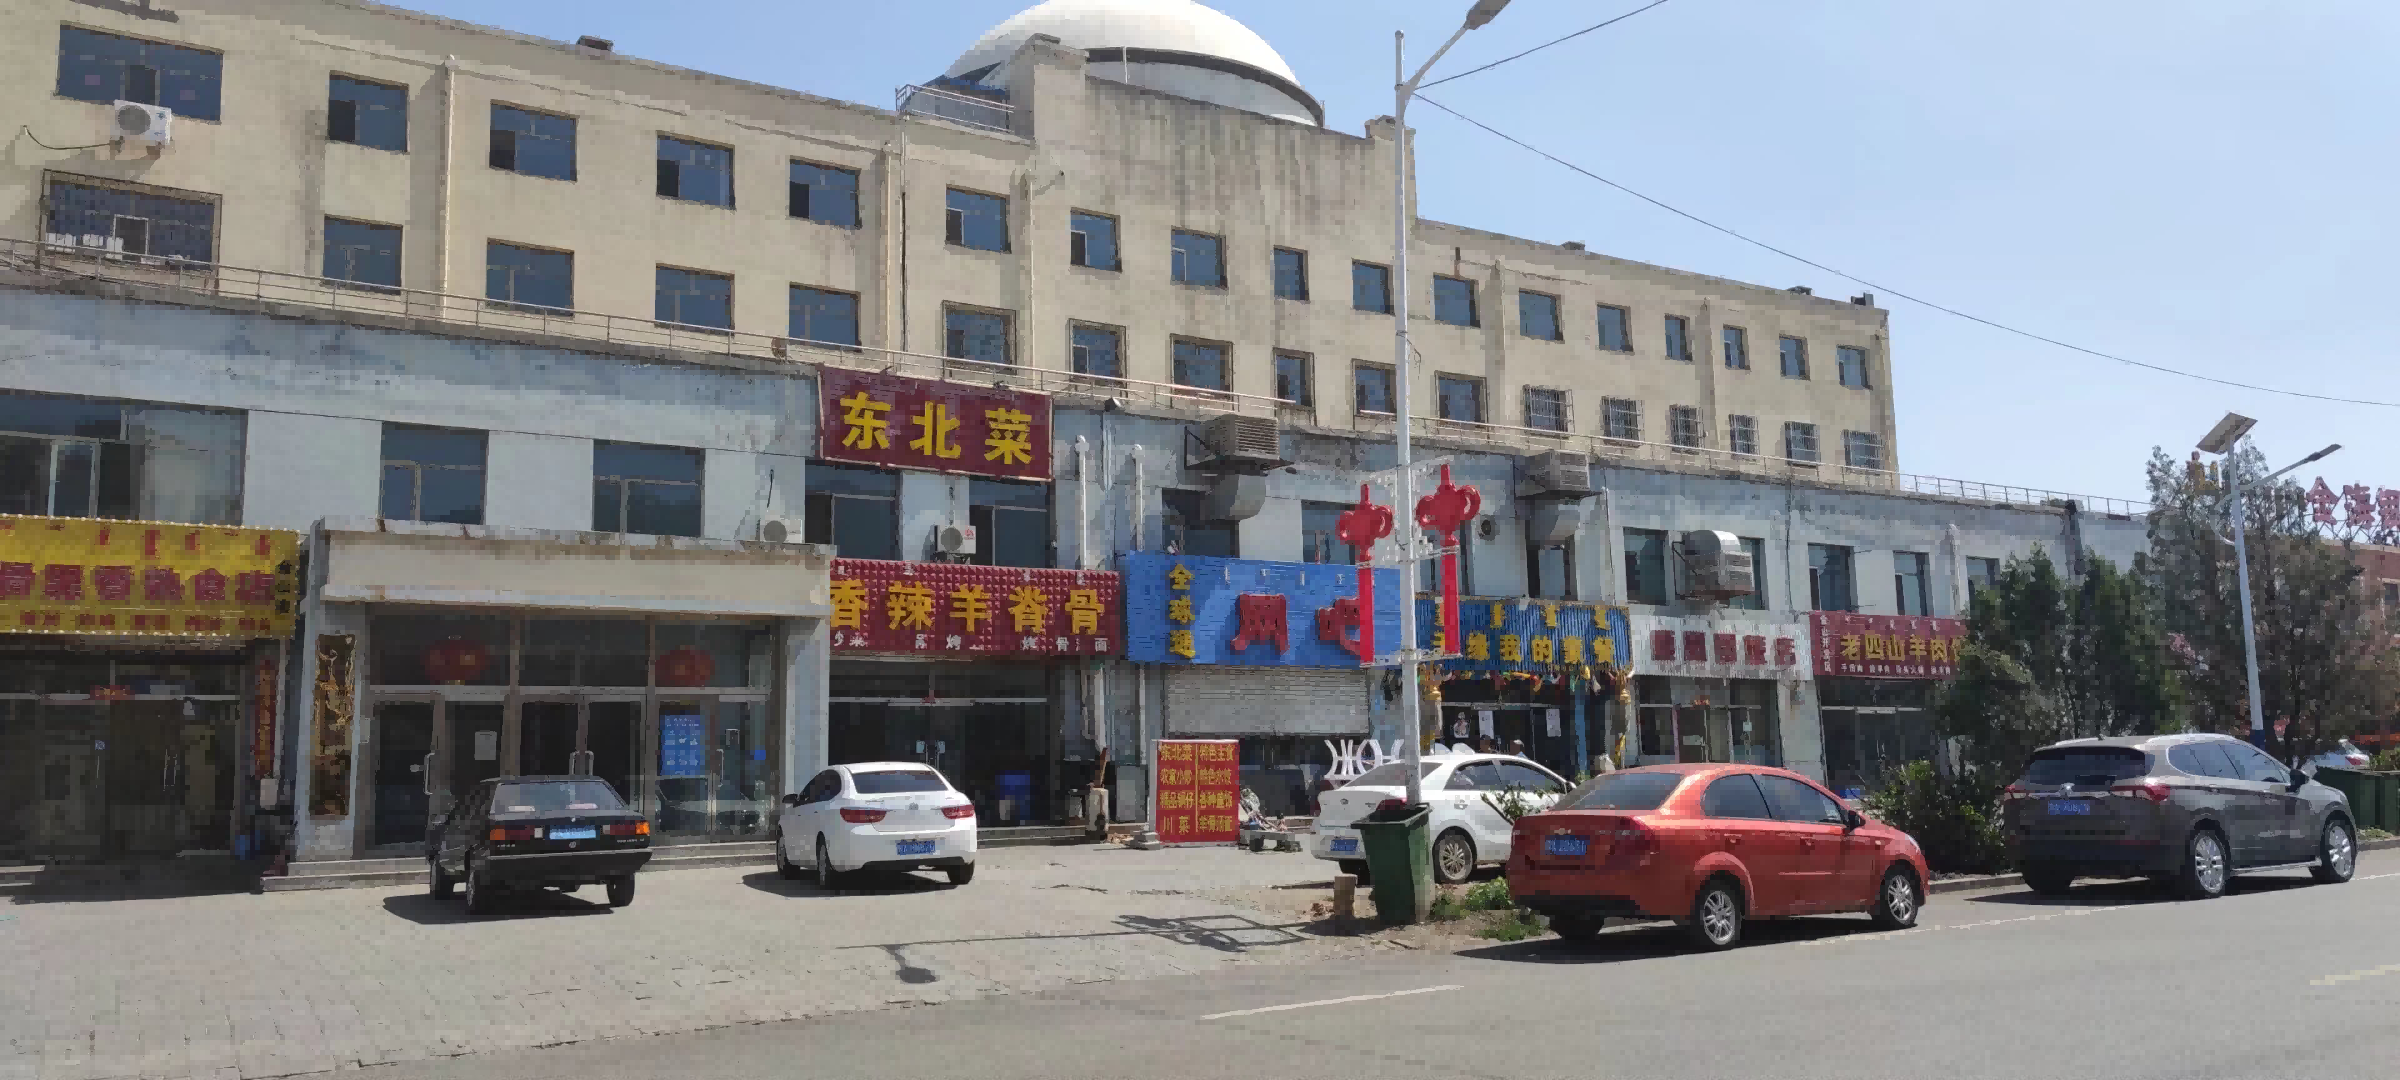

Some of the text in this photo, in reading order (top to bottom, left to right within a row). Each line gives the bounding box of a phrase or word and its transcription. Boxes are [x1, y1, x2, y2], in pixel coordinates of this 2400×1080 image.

[839, 390, 1034, 465] 东北菜
[829, 577, 1106, 635] 香辣羊脊骨
[1229, 592, 1362, 657] 网吧
